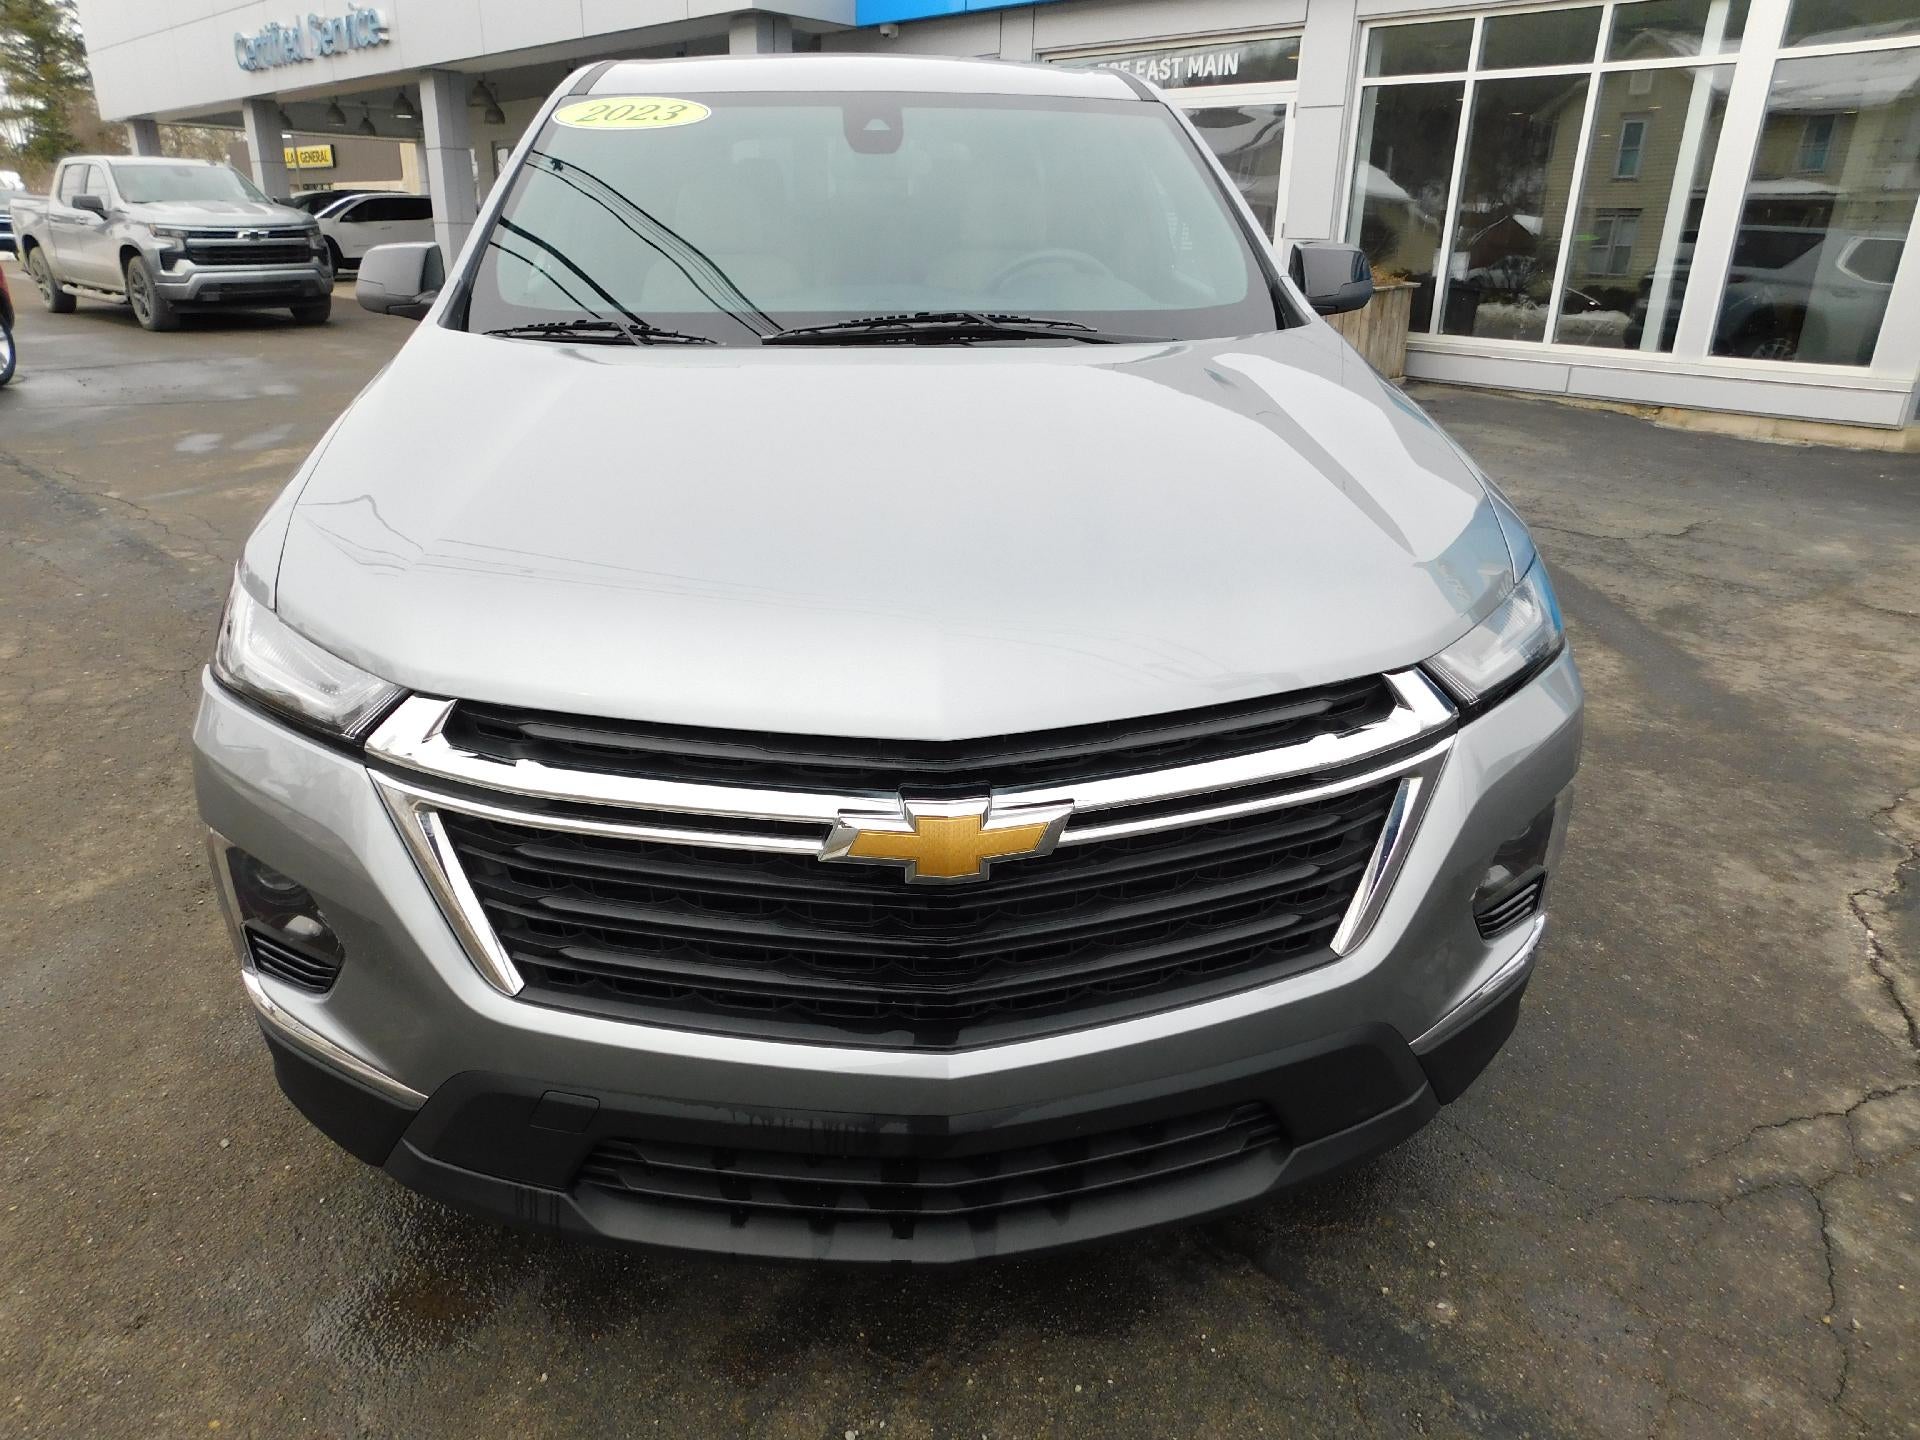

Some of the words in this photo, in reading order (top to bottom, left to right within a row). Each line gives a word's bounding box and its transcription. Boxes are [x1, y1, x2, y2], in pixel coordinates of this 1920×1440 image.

[234, 16, 307, 71] Certified
[308, 3, 388, 57] Service
[1187, 53, 1239, 78] MAIN
[575, 105, 687, 122] 2023
[300, 150, 329, 163] GENERAL
